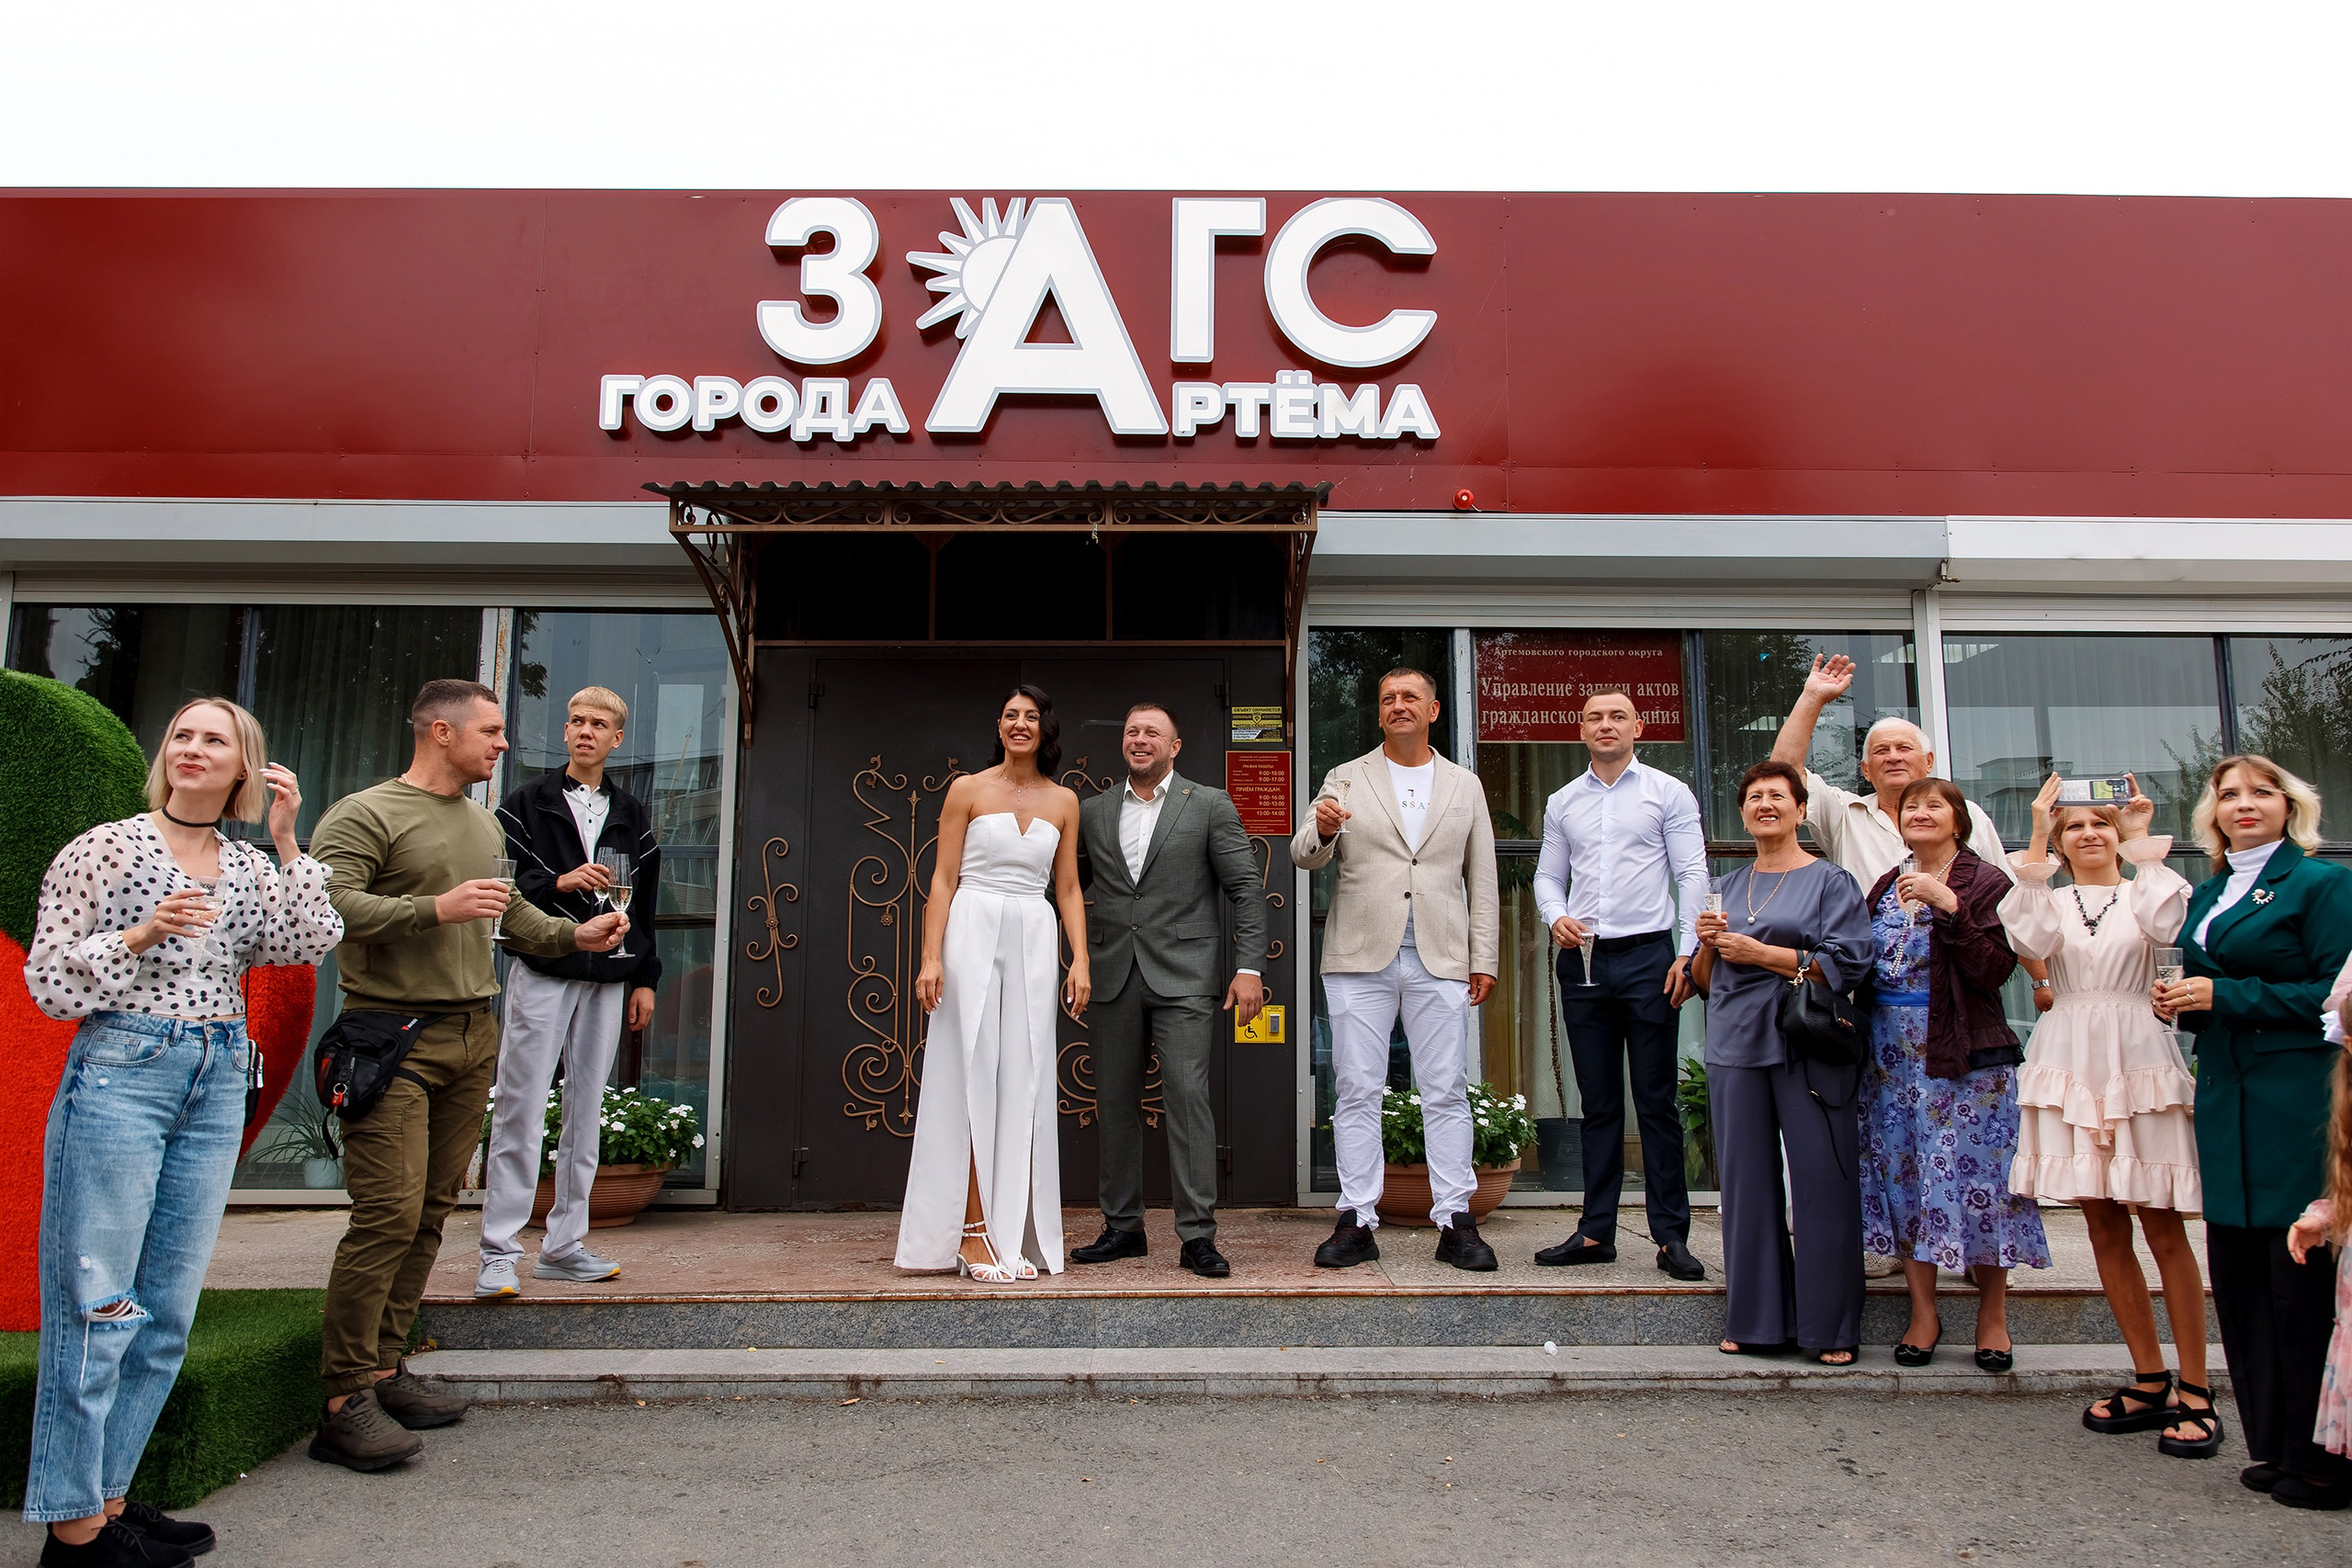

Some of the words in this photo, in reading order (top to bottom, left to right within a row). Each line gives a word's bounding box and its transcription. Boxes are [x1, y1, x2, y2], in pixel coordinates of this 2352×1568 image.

[757, 197, 1439, 435] ЗАГС
[598, 374, 910, 442] ГОРОДА
[1567, 649, 1625, 657] городского
[1628, 649, 1663, 657] округа
[1481, 677, 1573, 702] Управление
[1636, 682, 1679, 696] актов
[1481, 710, 1583, 731] гражданског
